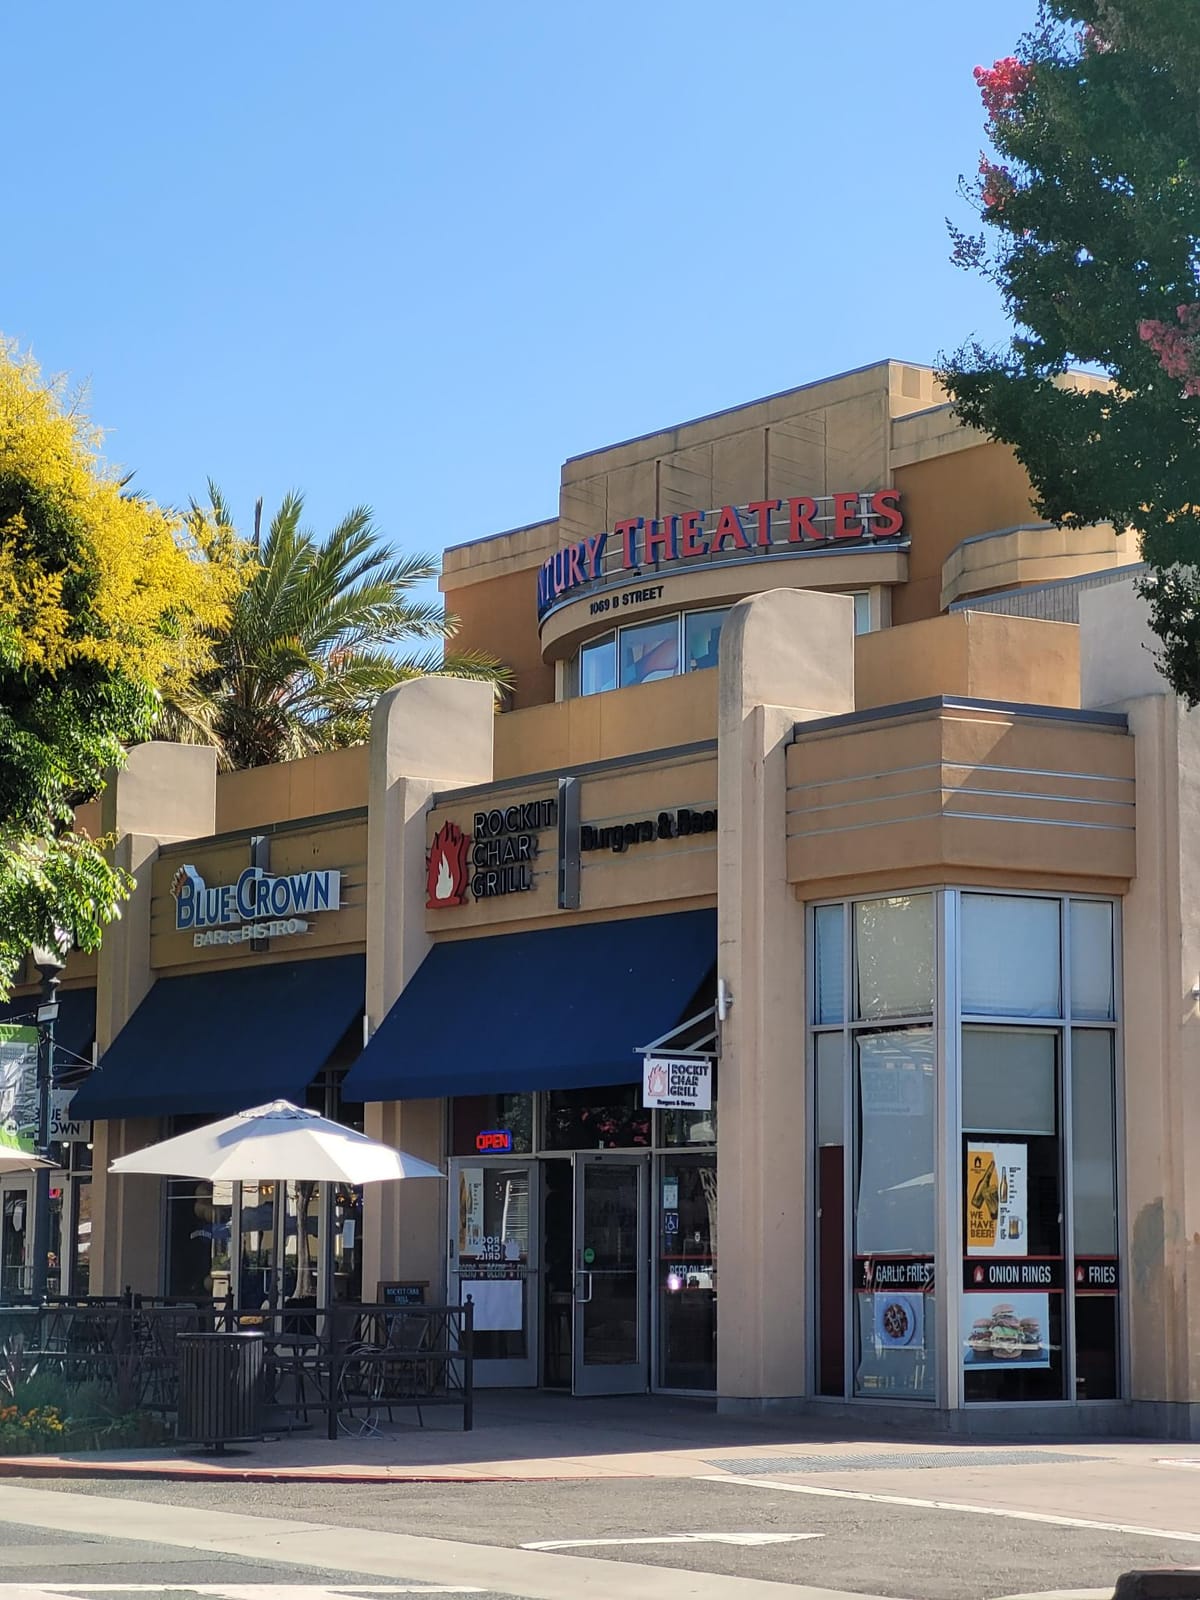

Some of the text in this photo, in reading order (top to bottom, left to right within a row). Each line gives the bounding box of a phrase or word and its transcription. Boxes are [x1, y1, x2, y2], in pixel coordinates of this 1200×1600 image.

[614, 489, 904, 569] THEATRES
[590, 585, 664, 615] 1069 B STREET
[474, 798, 555, 839] ROCKIT
[658, 812, 677, 839] &
[472, 833, 533, 868] CHAR
[471, 864, 532, 899] GRILL
[175, 867, 339, 930] BLUE CROWN
[193, 930, 228, 948] BAR
[241, 918, 308, 941] BISTRO
[670, 1075, 699, 1087] CHAR
[671, 1063, 709, 1077] ROCKIT
[24, 1043, 37, 1125] HAYWARD
[670, 1086, 698, 1097] GRILL
[475, 1134, 508, 1150] OPEN
[969, 1211, 984, 1220] WE
[969, 1221, 995, 1229] HAVE
[875, 1265, 930, 1282] GARLIC FRIES
[989, 1266, 1052, 1283] ONION RINGS
[1088, 1266, 1116, 1284] FRIES
